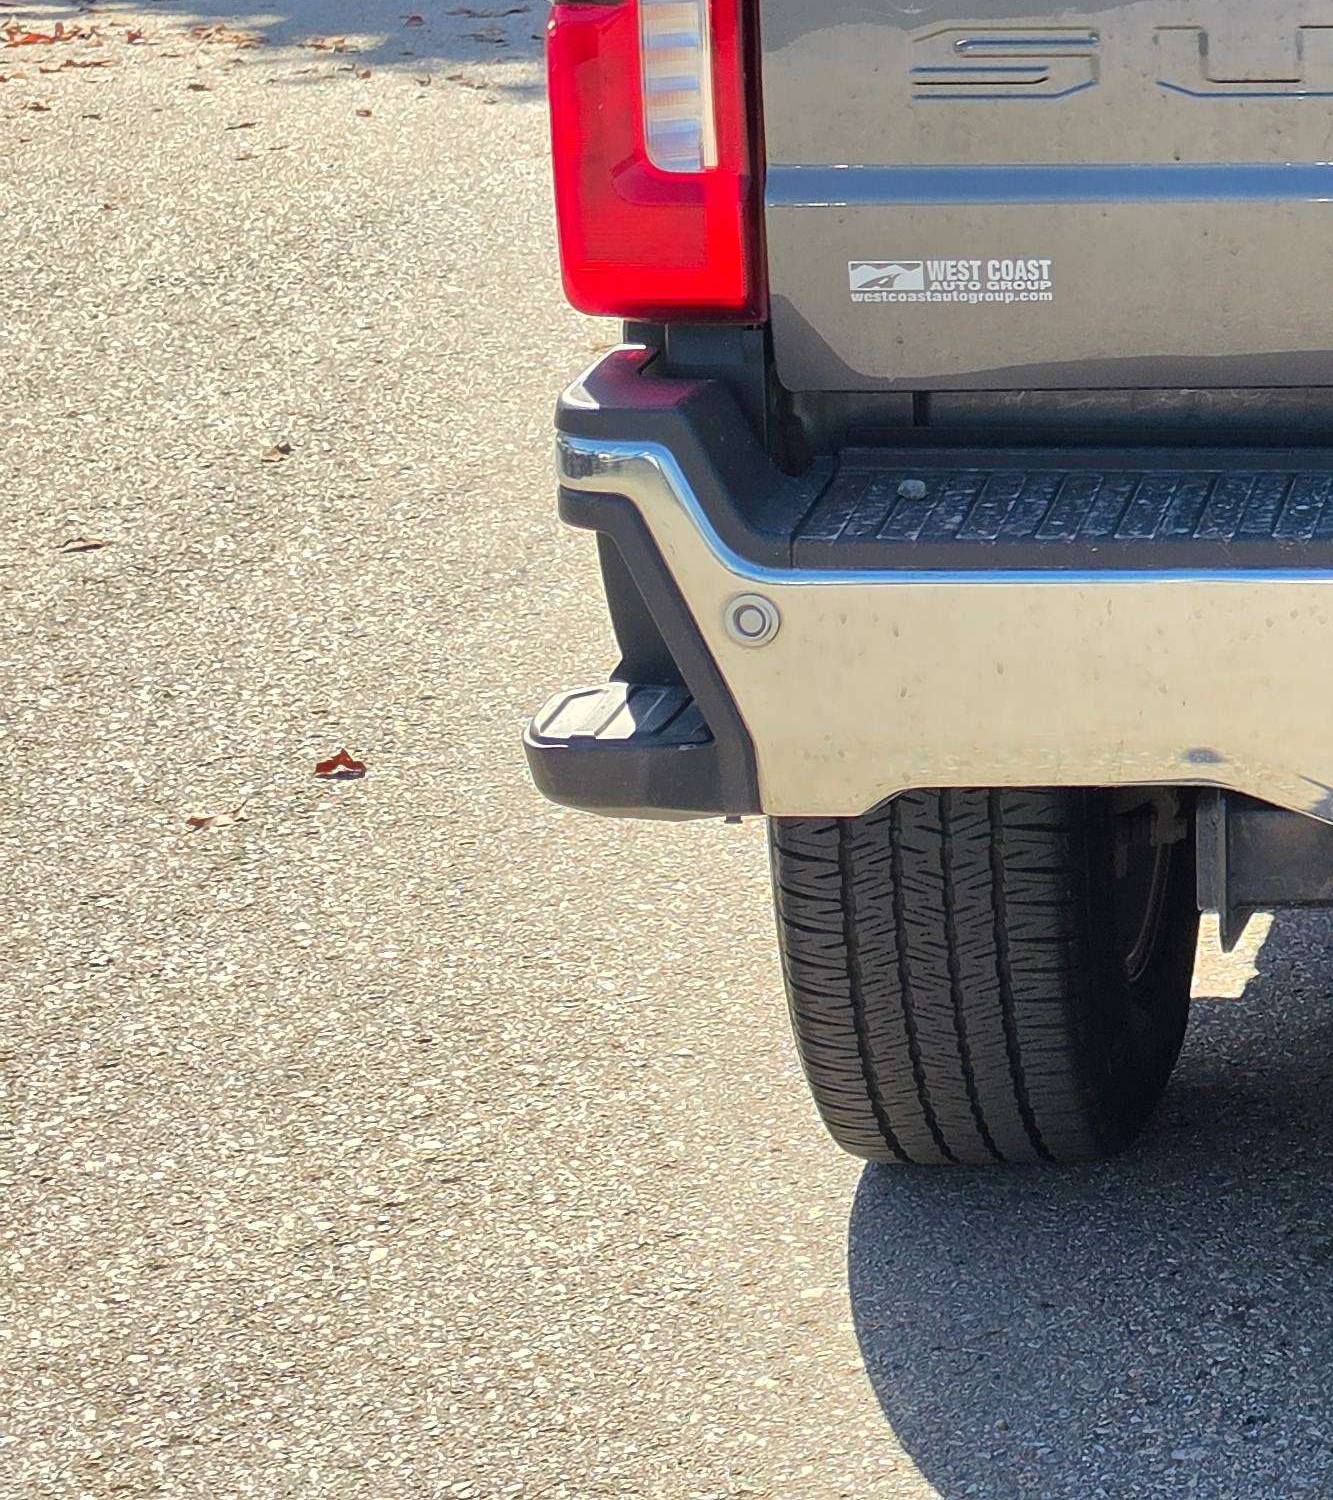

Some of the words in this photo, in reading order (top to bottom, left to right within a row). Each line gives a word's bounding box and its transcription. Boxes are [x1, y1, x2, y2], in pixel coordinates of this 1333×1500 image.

[927, 260, 982, 281] WEST
[987, 260, 1052, 281] COAST
[930, 281, 982, 291] AUTO
[986, 281, 1052, 291] GROUP
[851, 290, 1053, 304] westcoastautogroup.com
